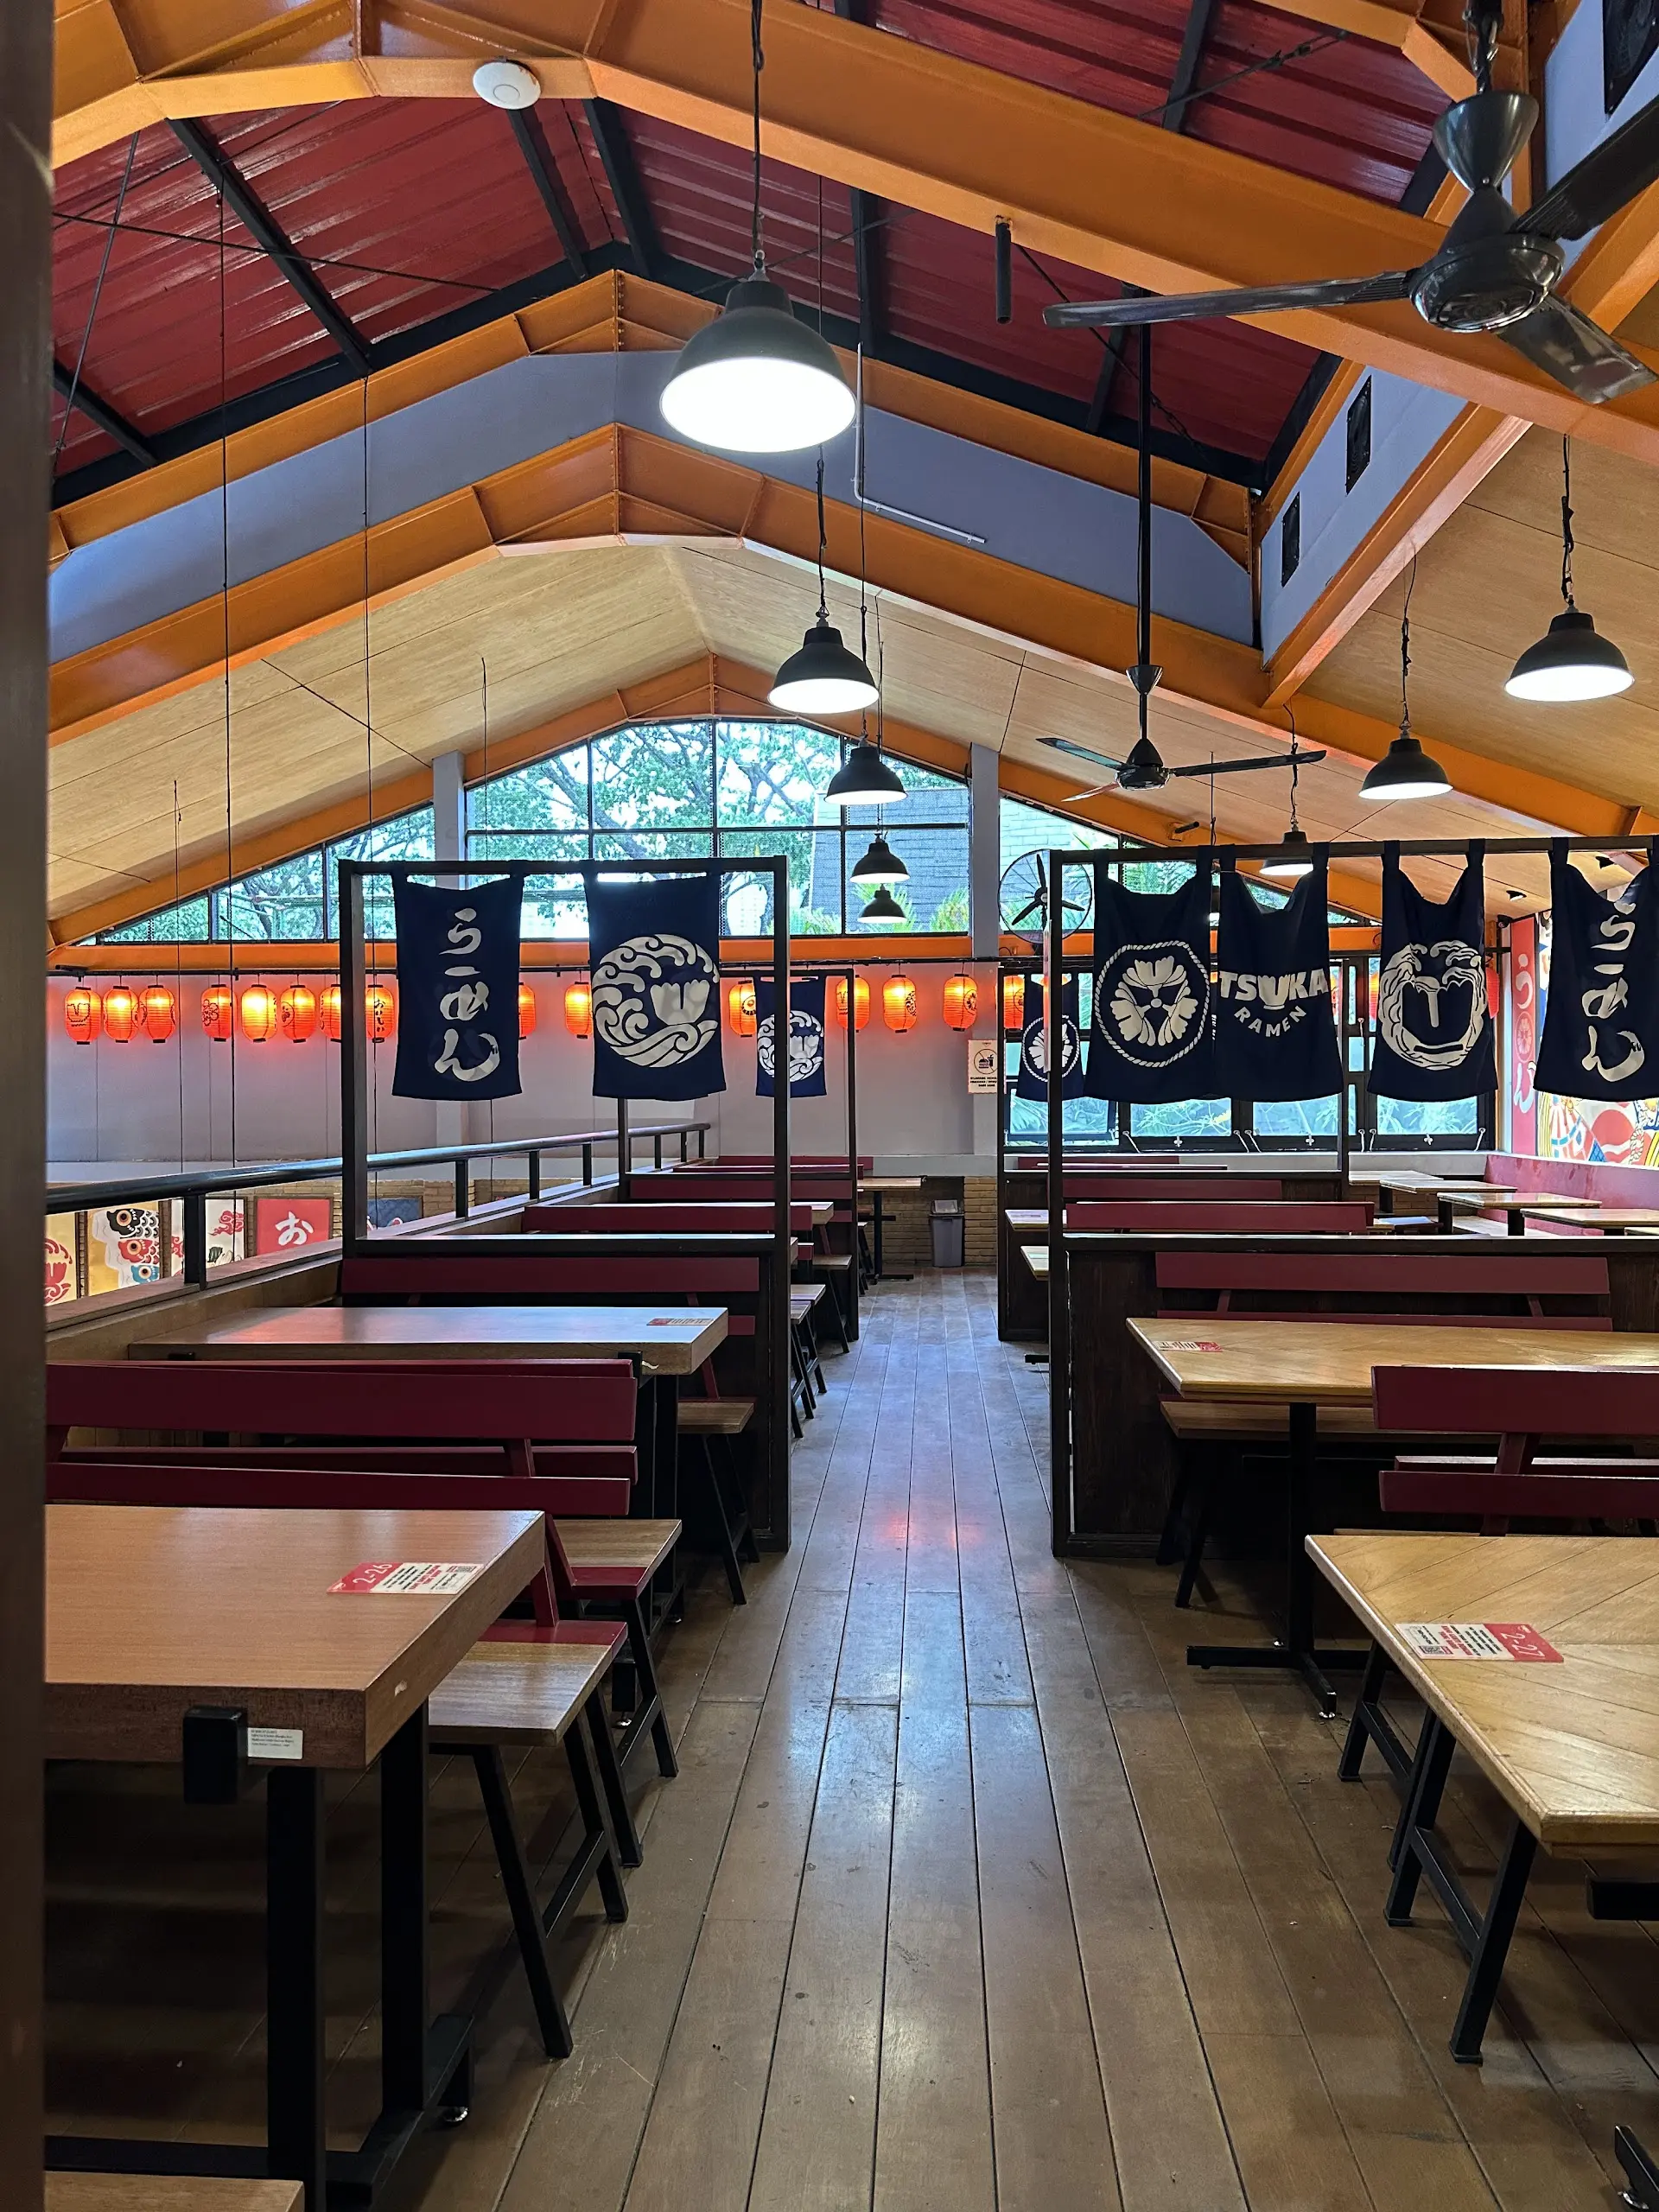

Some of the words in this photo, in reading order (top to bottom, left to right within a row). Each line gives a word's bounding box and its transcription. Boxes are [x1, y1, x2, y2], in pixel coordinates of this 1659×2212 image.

[1218, 968, 1330, 1011] TSUKA
[1233, 1005, 1307, 1038] RAMEN
[274, 1210, 315, 1246] お
[353, 1562, 393, 1585] 2-26
[1500, 1631, 1546, 1659] 2-27
